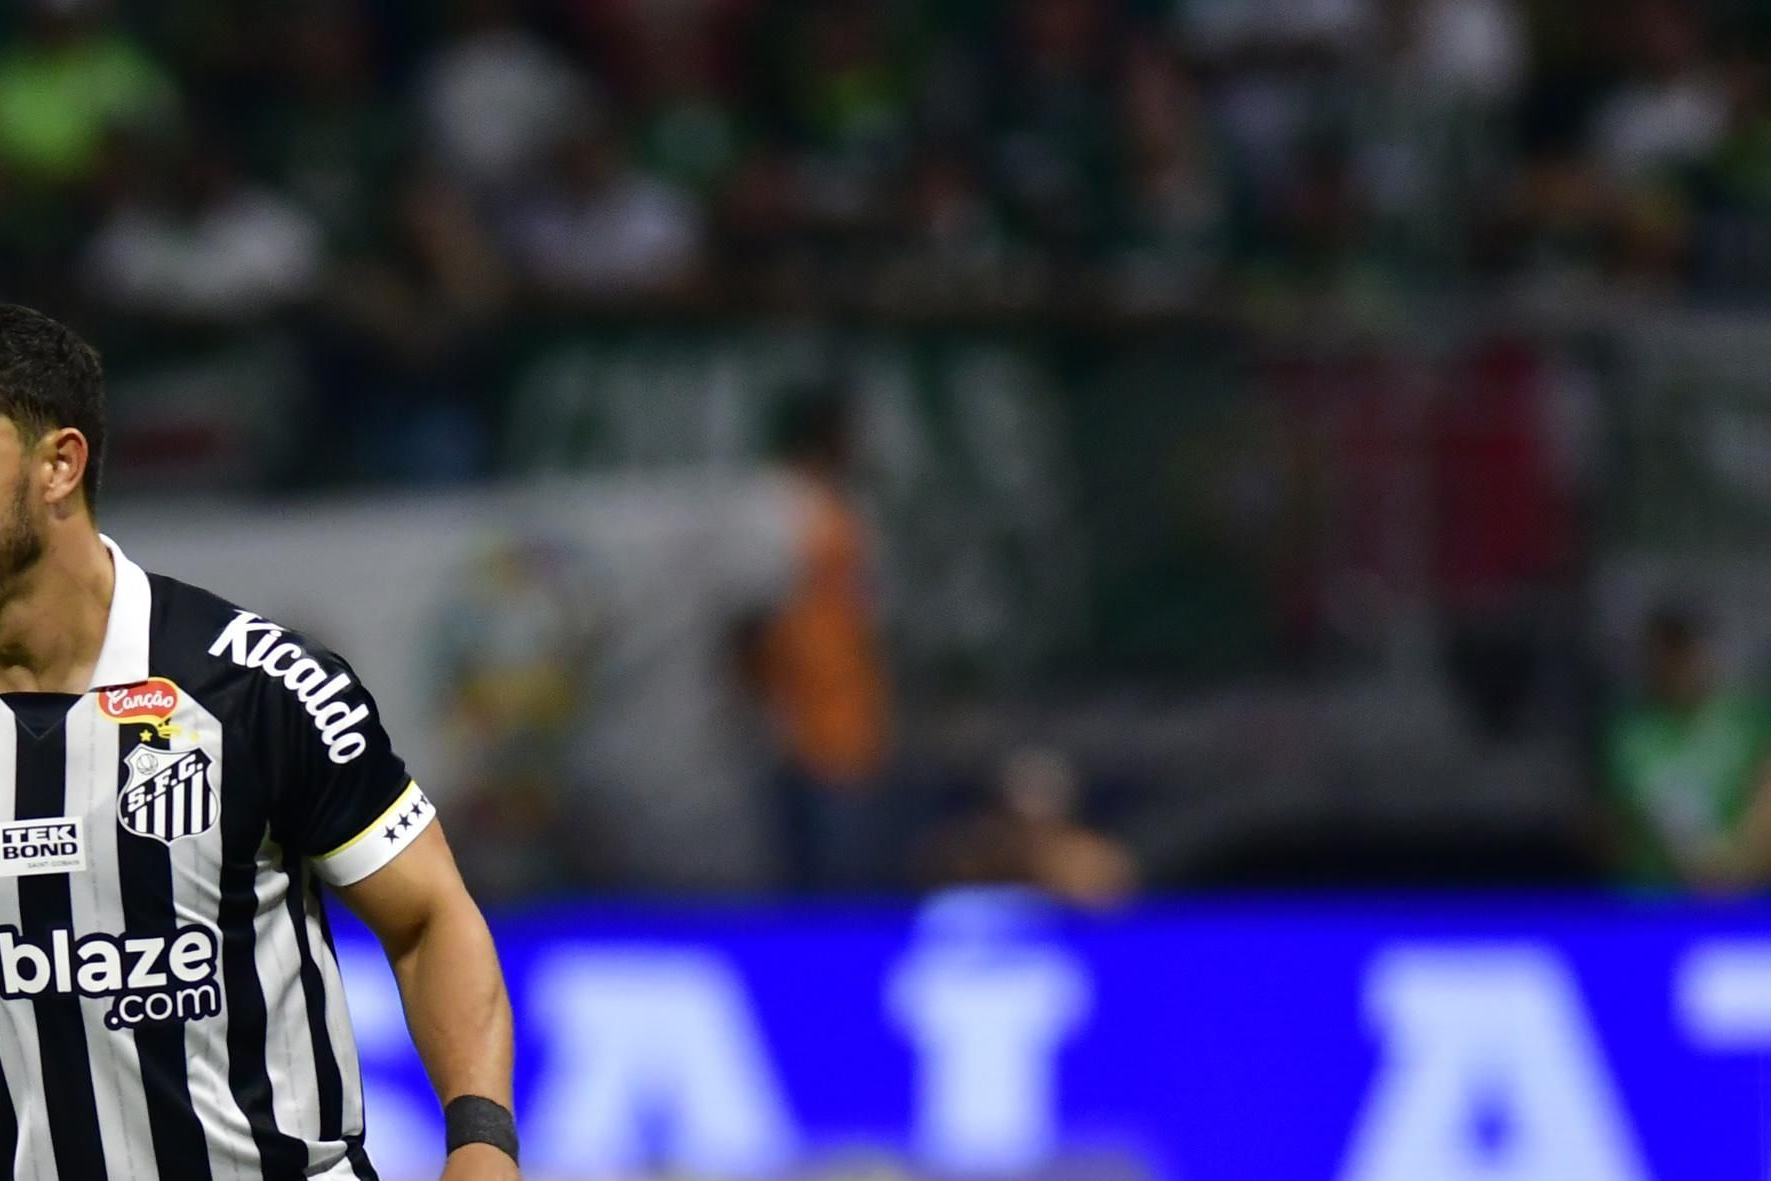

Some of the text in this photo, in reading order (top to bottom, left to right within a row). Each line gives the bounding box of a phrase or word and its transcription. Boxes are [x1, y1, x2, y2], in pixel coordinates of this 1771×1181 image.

[208, 609, 369, 764] Kicaldo
[106, 688, 174, 715] Canção
[3, 824, 76, 843] TEK
[3, 842, 78, 860] BOND
[110, 984, 217, 1025] .com
